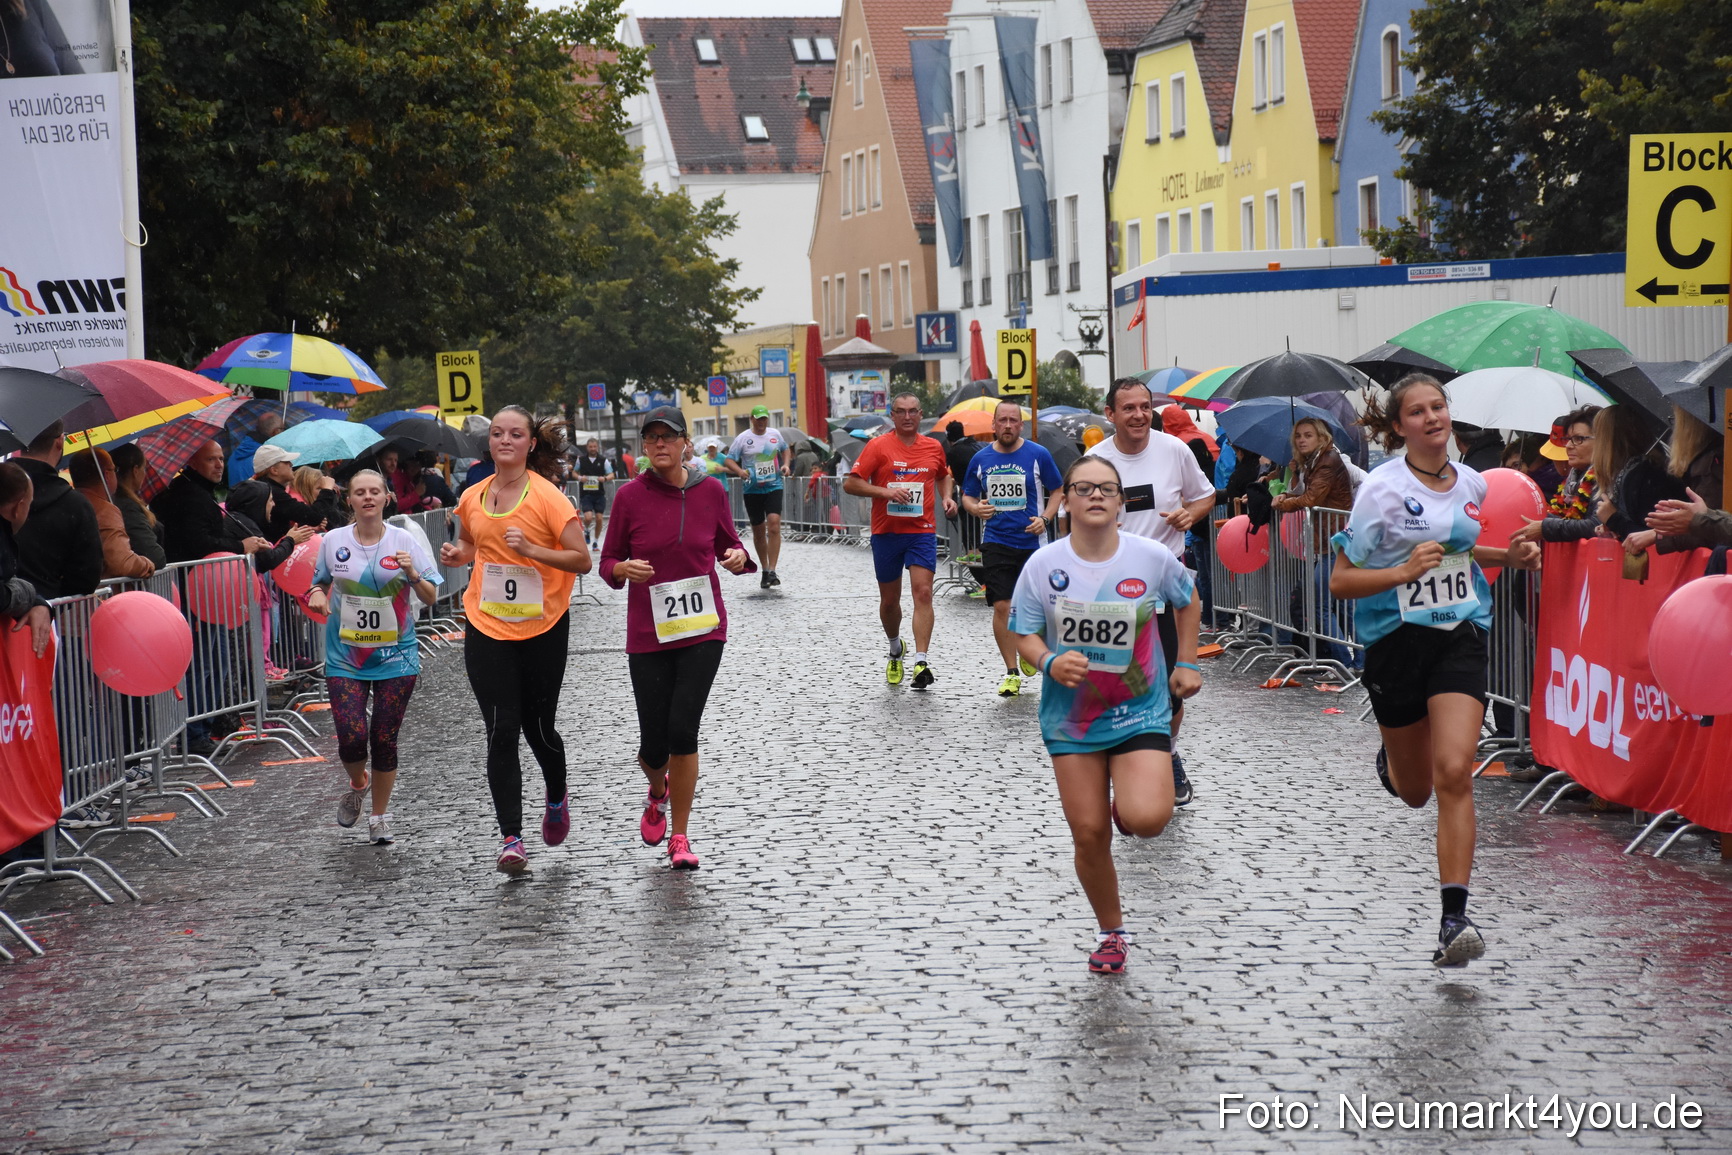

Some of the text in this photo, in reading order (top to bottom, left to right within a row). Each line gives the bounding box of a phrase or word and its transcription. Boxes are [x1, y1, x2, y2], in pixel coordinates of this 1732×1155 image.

[1643, 140, 1732, 172] Block
[1161, 171, 1189, 204] HOTEL
[1655, 184, 1717, 270] C
[1001, 331, 1033, 344] Block
[441, 353, 476, 367] Block
[1007, 348, 1028, 381] D
[448, 371, 472, 402] D
[590, 400, 605, 408] TAXI
[710, 396, 726, 404] TAXI
[985, 464, 1000, 474] Wyk
[1011, 462, 1027, 474] Föhr
[991, 483, 1023, 497] 2336
[504, 579, 517, 601] 9
[1405, 571, 1468, 608] 2116
[486, 604, 524, 615] Melinda
[664, 591, 703, 619] 210
[1089, 604, 1129, 614] BOCK
[356, 609, 381, 630] 30
[1431, 611, 1458, 623] Rosa
[354, 632, 382, 642] Sandra
[1061, 616, 1130, 647] 2682
